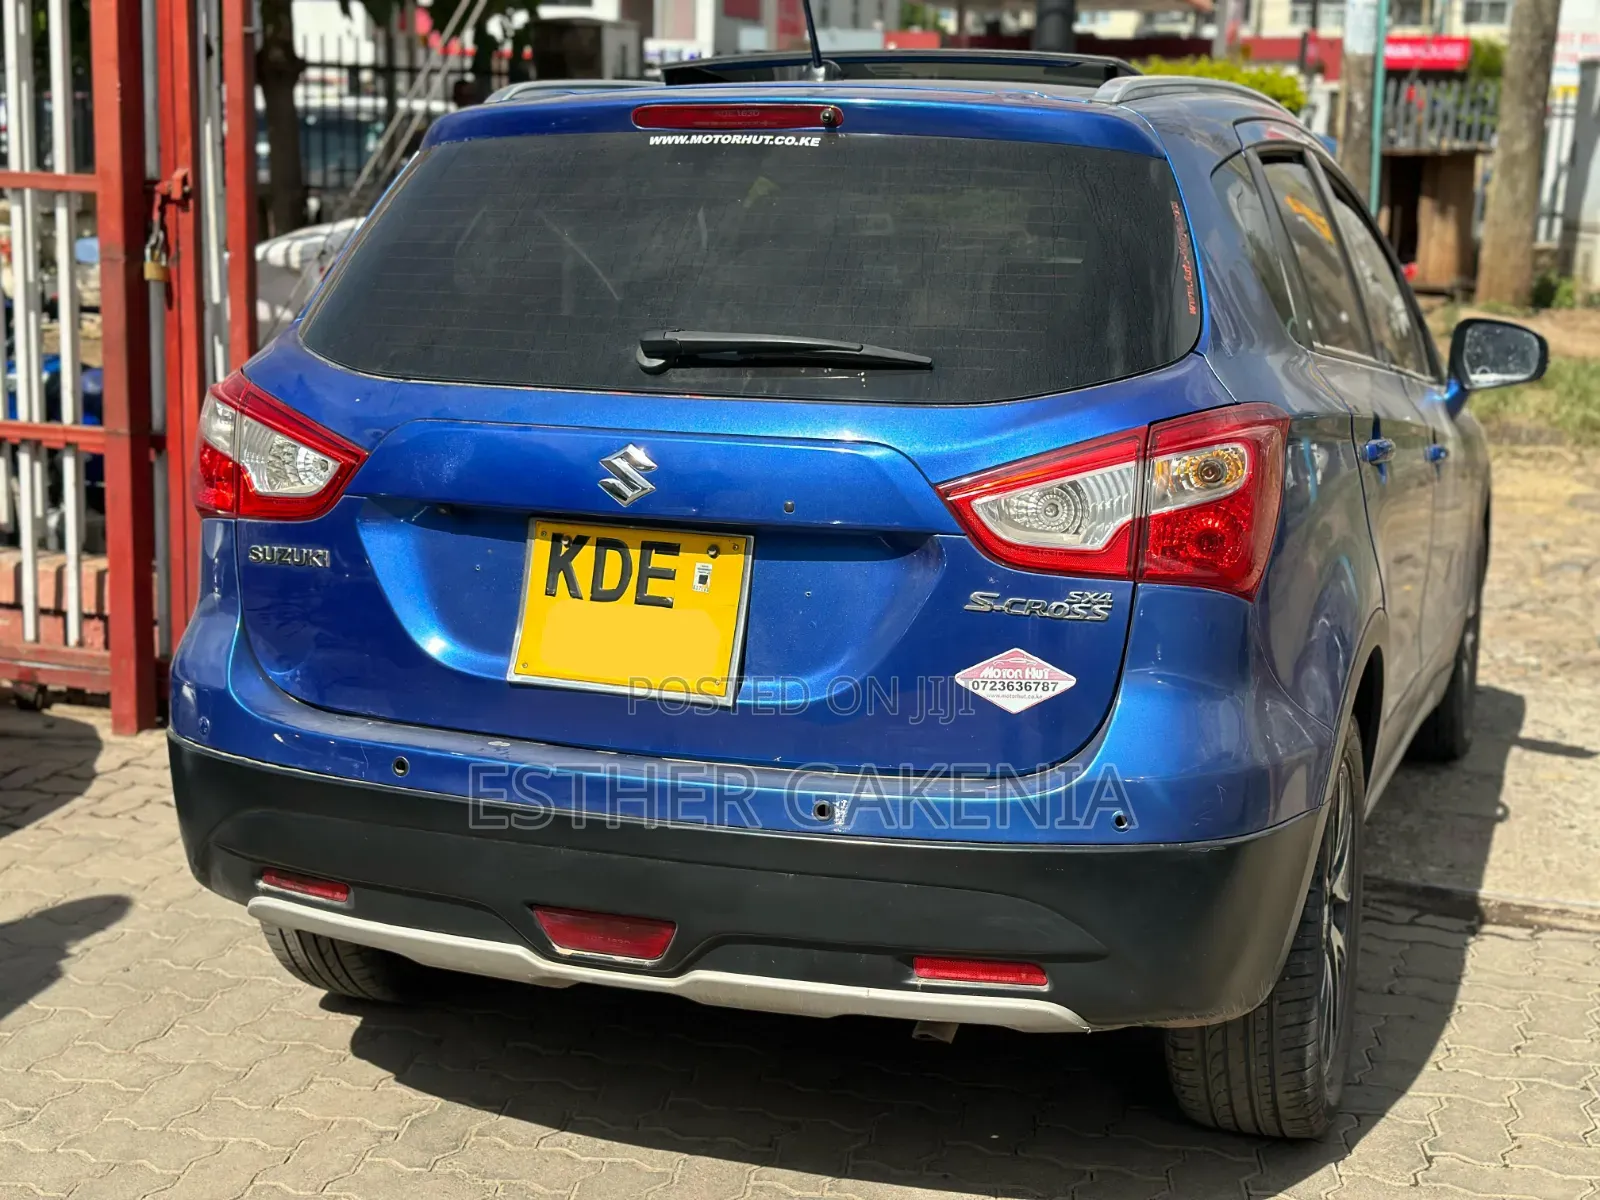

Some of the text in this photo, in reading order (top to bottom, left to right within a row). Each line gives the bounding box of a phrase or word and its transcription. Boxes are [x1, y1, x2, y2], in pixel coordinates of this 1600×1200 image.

[650, 134, 821, 147] WWW.MOTORHUT.CO.KE
[248, 544, 331, 568] SUZUKI
[545, 532, 681, 609] KDE
[1064, 591, 1114, 603] SX4
[971, 680, 1059, 693] 0723636787
